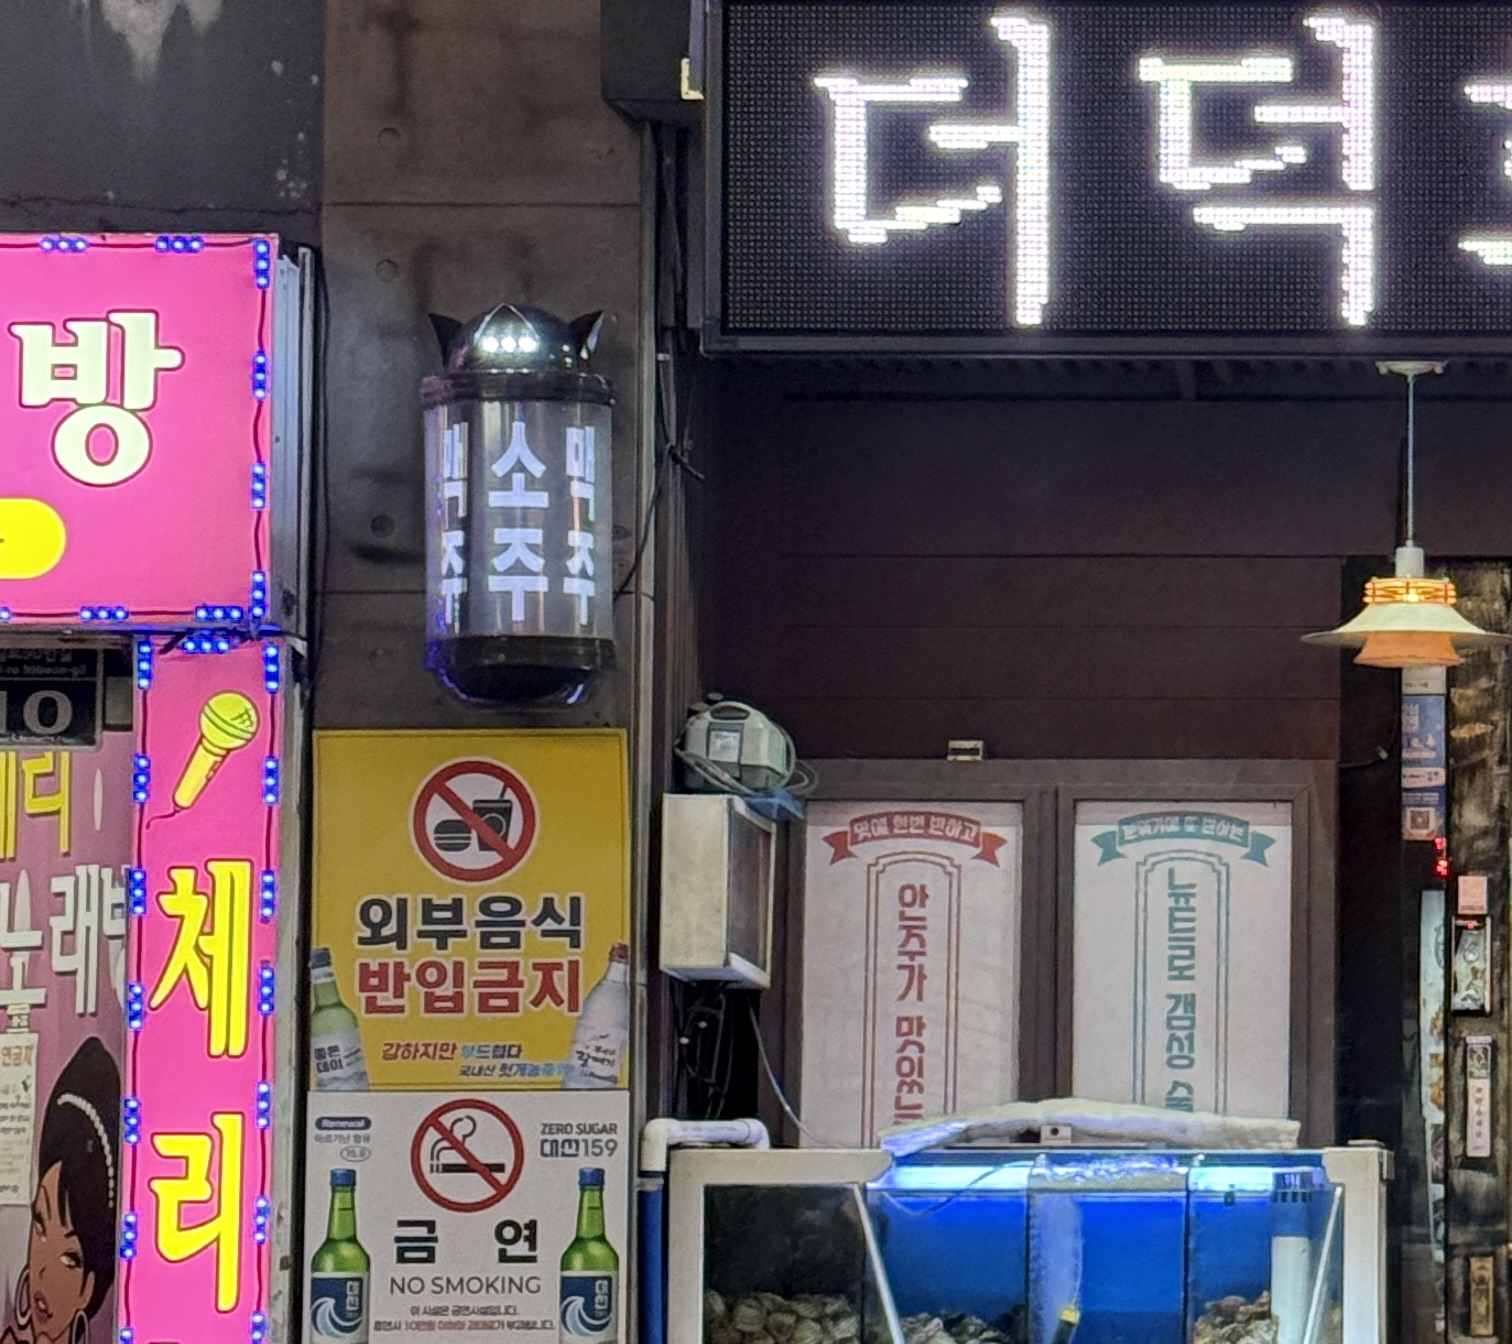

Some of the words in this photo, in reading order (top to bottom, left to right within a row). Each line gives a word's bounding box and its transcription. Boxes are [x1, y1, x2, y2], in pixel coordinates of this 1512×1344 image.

[8, 309, 186, 488] 방
[487, 420, 549, 623] 소주
[893, 815, 924, 834] 한번
[357, 895, 583, 951] 외부음식
[897, 883, 929, 1002] 안주가
[1167, 867, 1197, 981] 뉴트로
[357, 959, 581, 1014] 반입금지
[382, 1042, 458, 1061] 강하지만
[1165, 993, 1196, 1070] 감성
[541, 1122, 574, 1135] ZERO
[575, 1122, 618, 1135] SUGAR
[389, 1276, 425, 1295] NO
[432, 1275, 542, 1296] SMOKING
